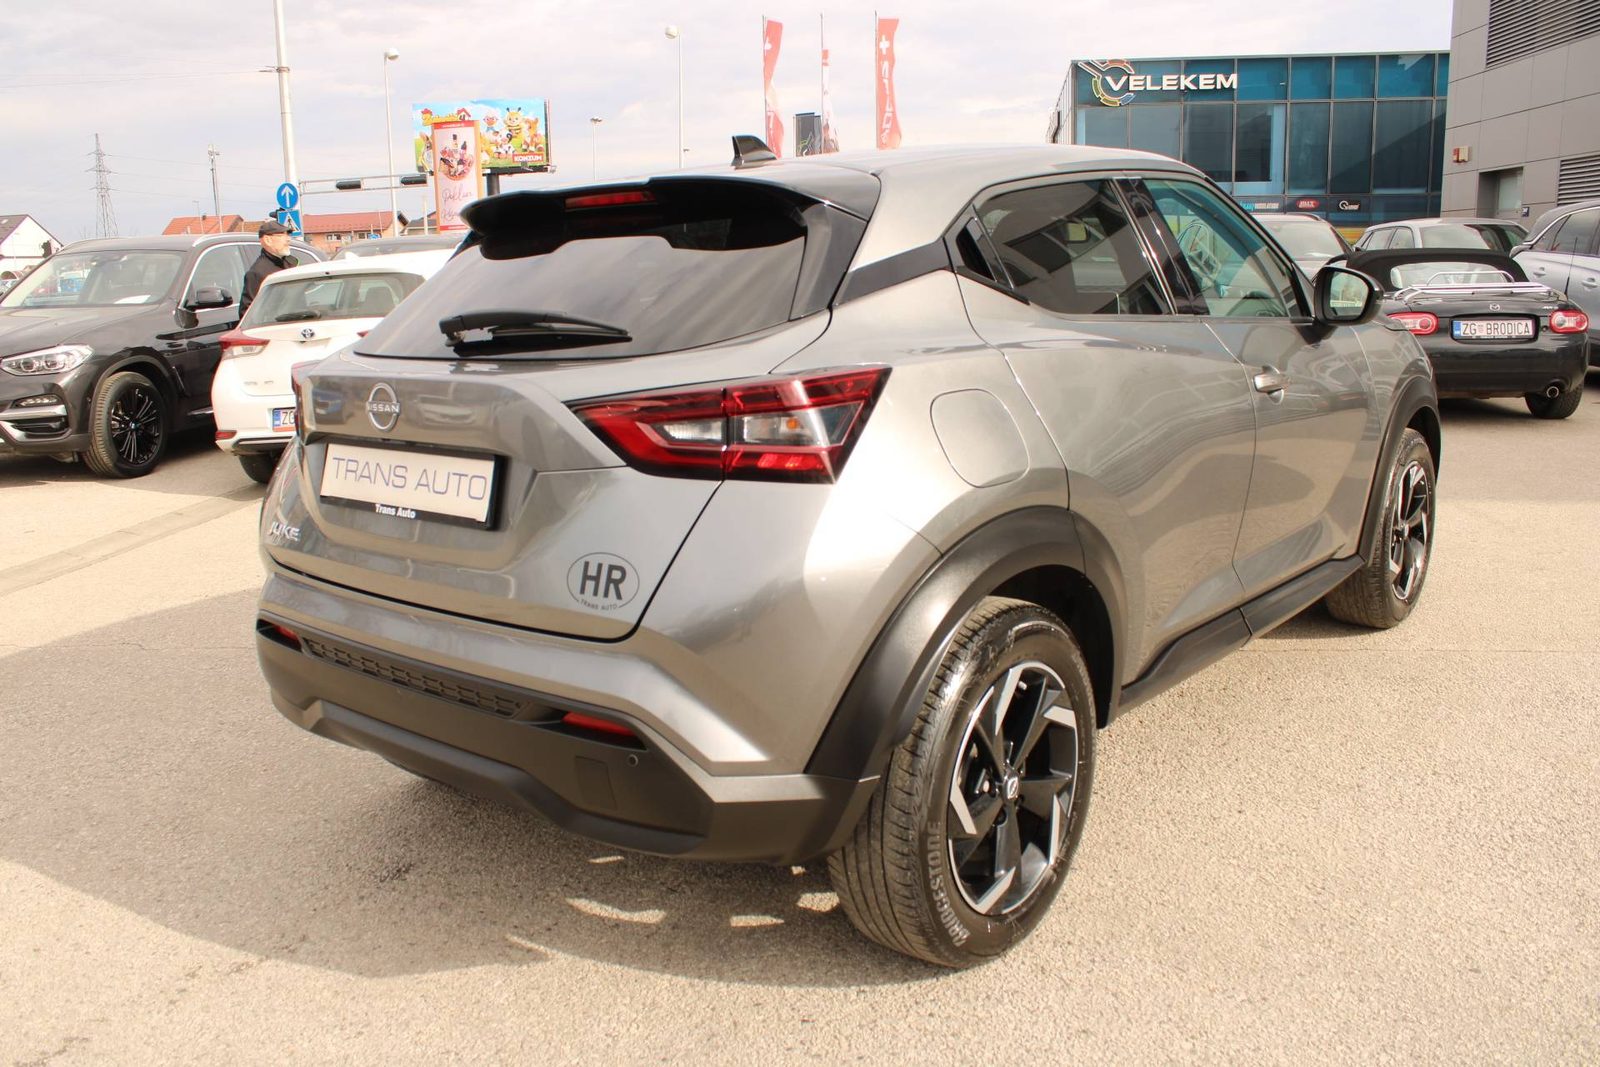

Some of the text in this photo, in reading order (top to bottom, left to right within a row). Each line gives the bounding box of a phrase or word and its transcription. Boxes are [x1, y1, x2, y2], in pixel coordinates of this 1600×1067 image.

[1104, 73, 1238, 91] VELEKEM
[1462, 322, 1530, 335] ZG BRODICA
[332, 457, 488, 501] TRANS AUTO
[375, 503, 416, 519] Trans Auto
[579, 560, 627, 600] HR
[580, 598, 618, 611] TRANS AUTO
[926, 820, 971, 948] BRIDGESTONE
